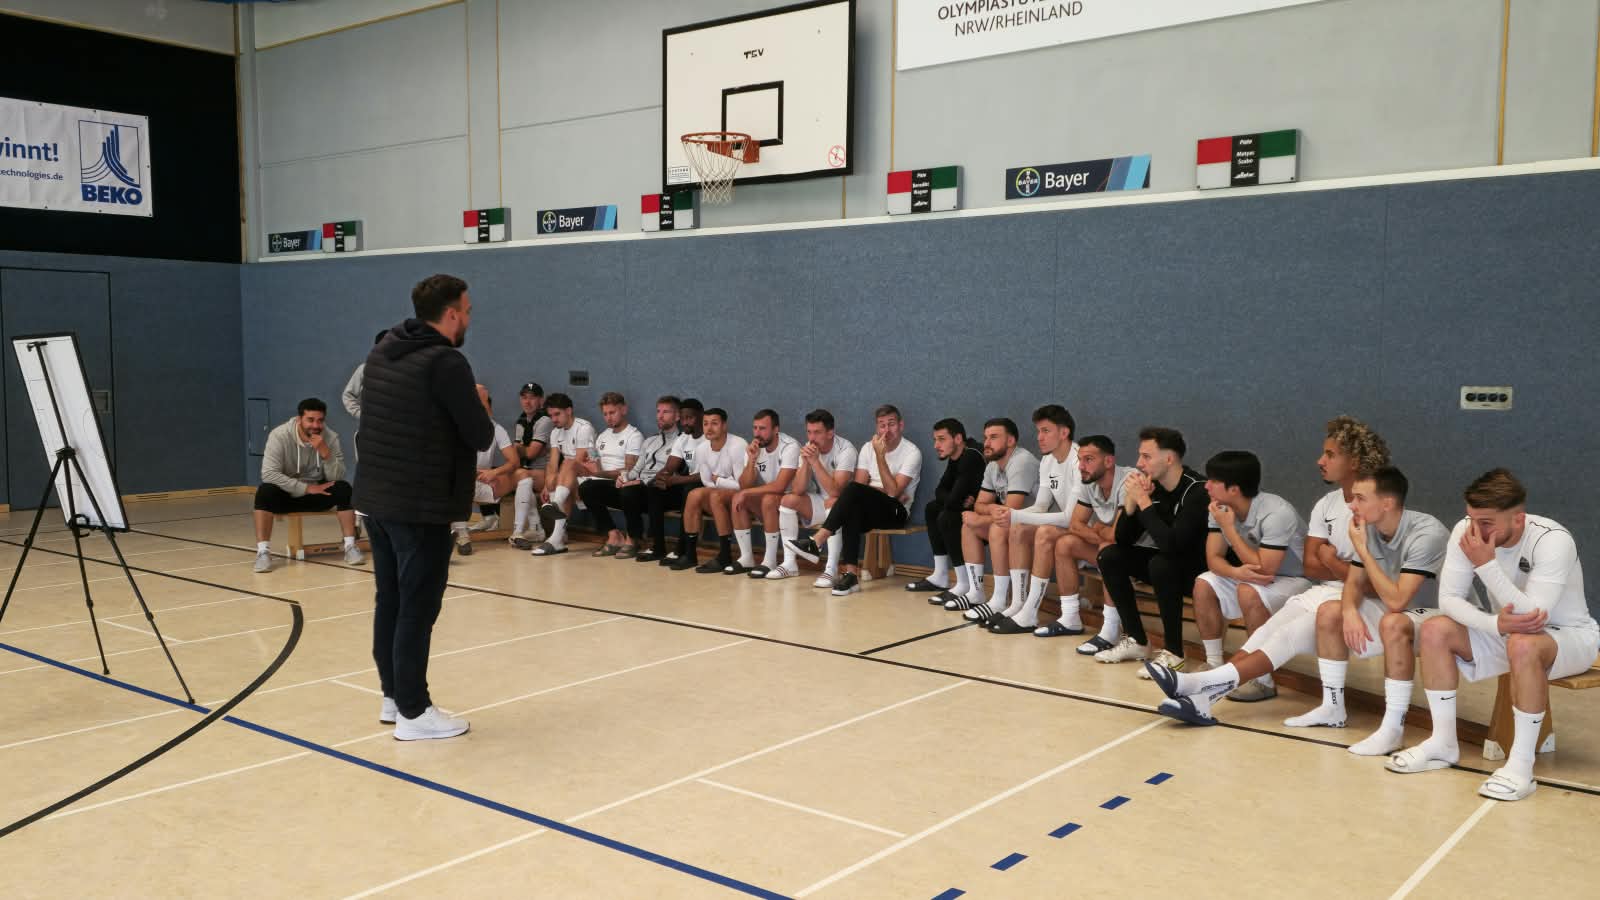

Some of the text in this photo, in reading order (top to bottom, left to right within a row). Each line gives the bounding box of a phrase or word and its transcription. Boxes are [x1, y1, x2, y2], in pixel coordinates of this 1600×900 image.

[954, 1, 1083, 36] NRW/RHEINLAND
[0, 168, 64, 181] echnologies.de
[1045, 171, 1090, 192] Bayer
[81, 183, 143, 205] BEKO
[558, 214, 585, 231] Bayer
[283, 237, 301, 249] Bayer
[759, 464, 767, 472] 12
